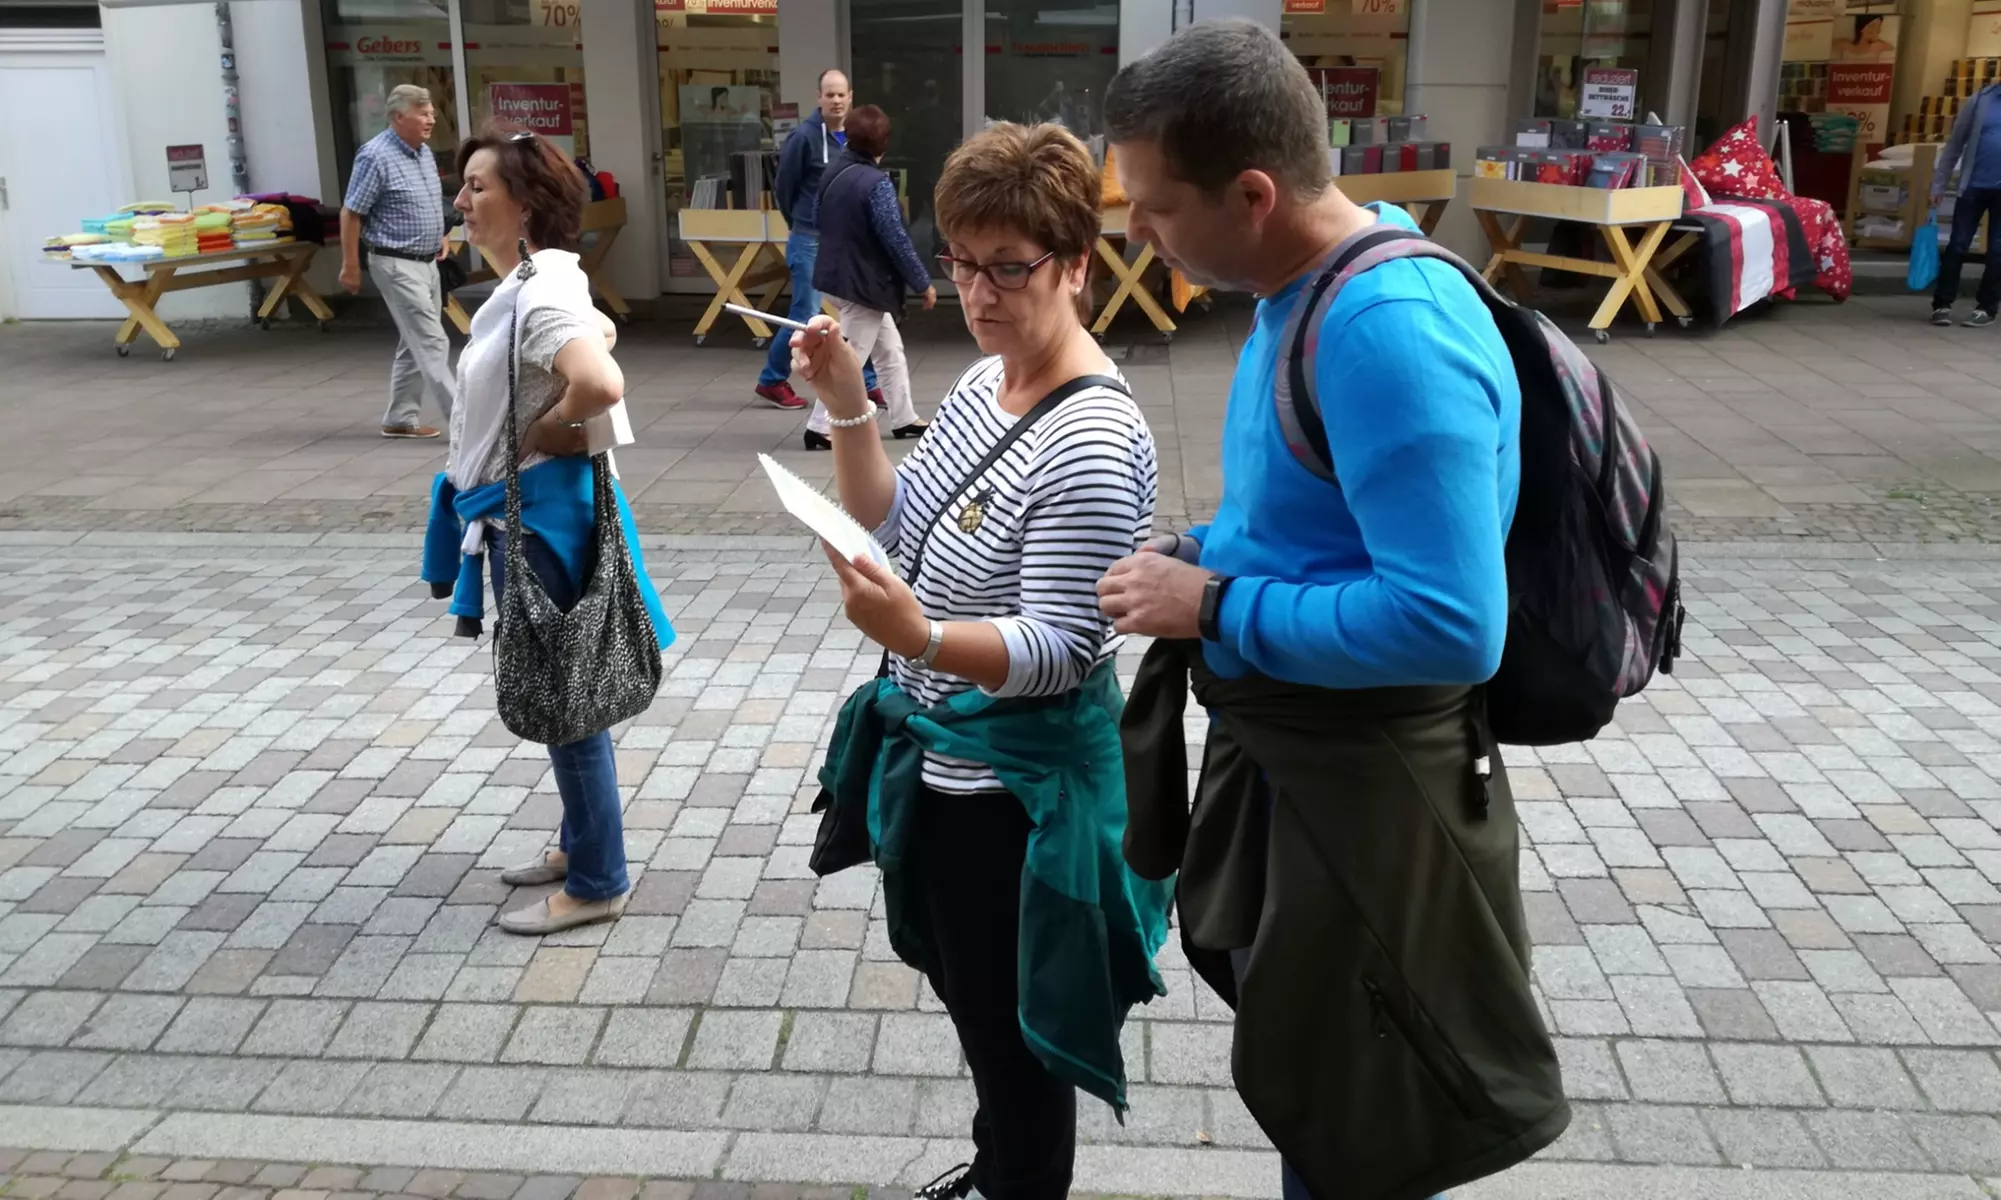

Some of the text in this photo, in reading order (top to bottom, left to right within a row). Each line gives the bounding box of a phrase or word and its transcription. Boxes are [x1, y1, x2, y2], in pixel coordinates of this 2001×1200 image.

[356, 35, 422, 54] Gebers
[1831, 71, 1890, 83] Inventur-
[1837, 85, 1884, 97] verkauf
[498, 96, 564, 111] Inventur-
